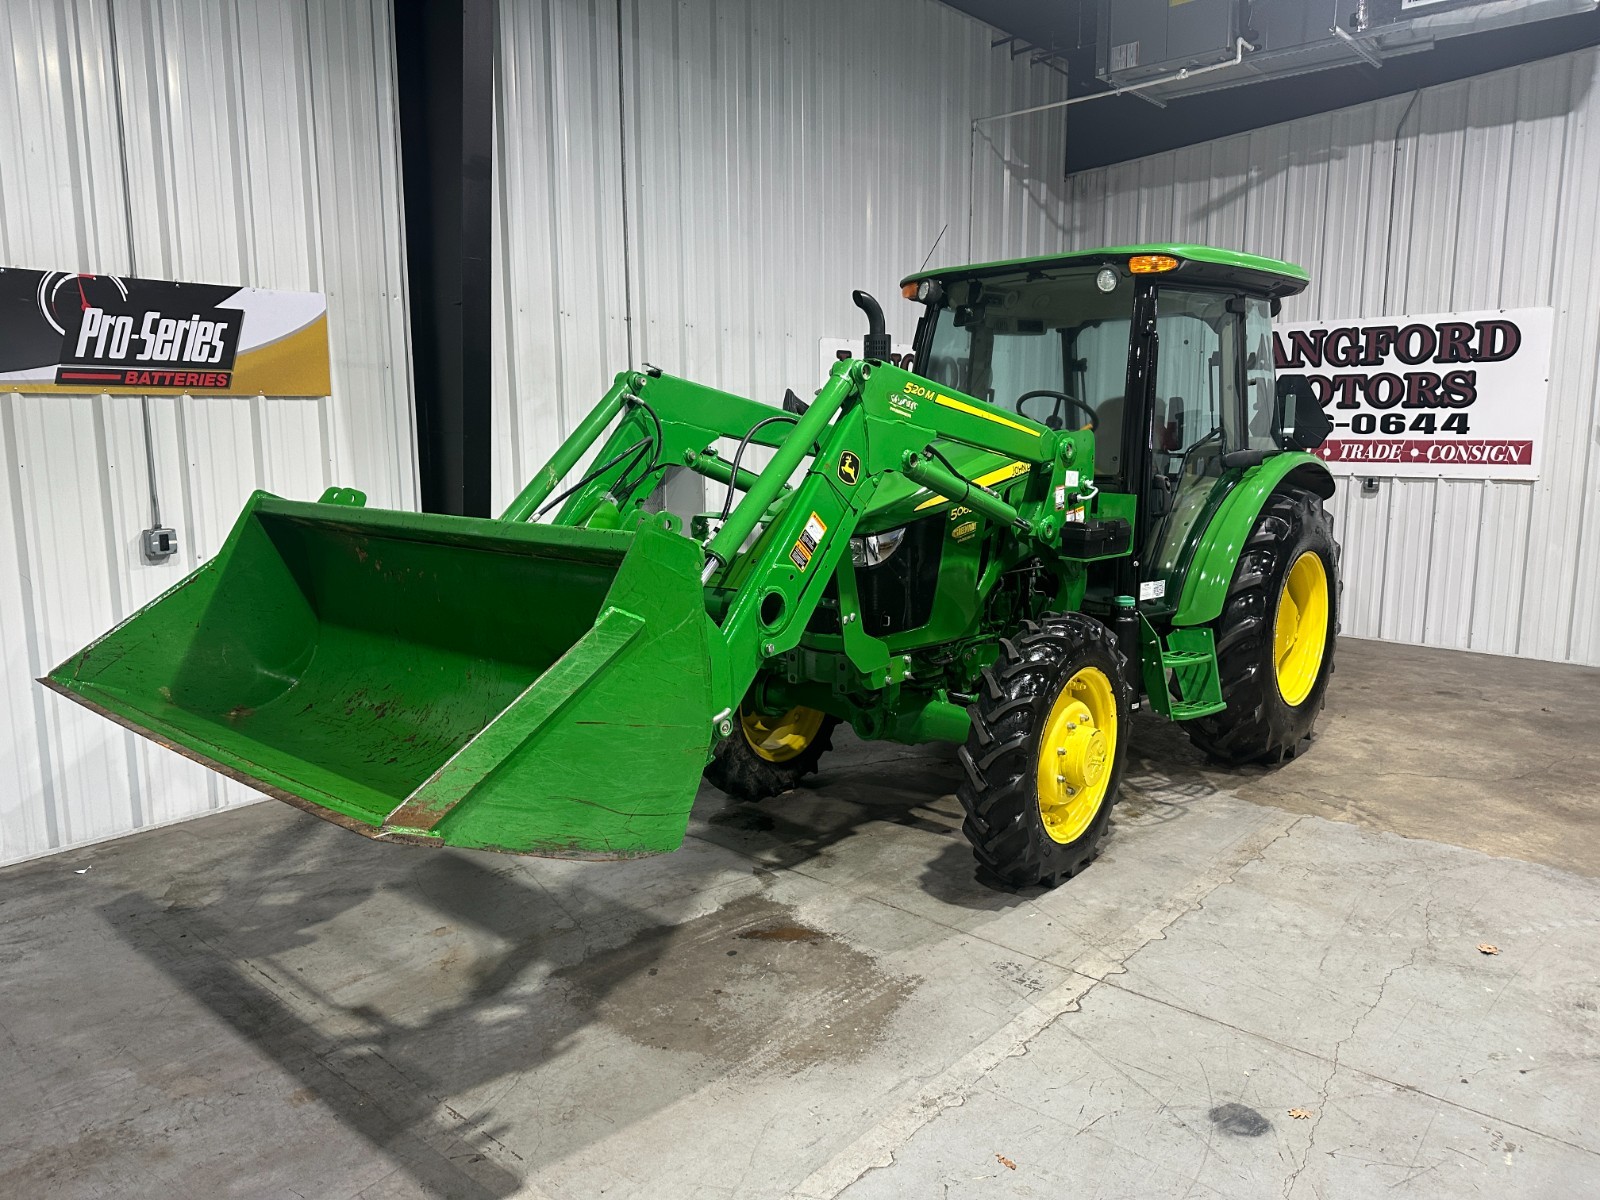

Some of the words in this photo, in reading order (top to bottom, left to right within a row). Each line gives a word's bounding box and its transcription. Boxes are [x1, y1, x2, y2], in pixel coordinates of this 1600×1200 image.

[75, 307, 229, 364] Pro-Series
[1266, 319, 1522, 369] ANGFORD
[125, 371, 228, 387] BATTERIES
[1306, 370, 1478, 410] OTORS
[1339, 443, 1403, 460] TRADE
[1426, 444, 1524, 462] CONSIGN
[950, 506, 973, 521] 506
